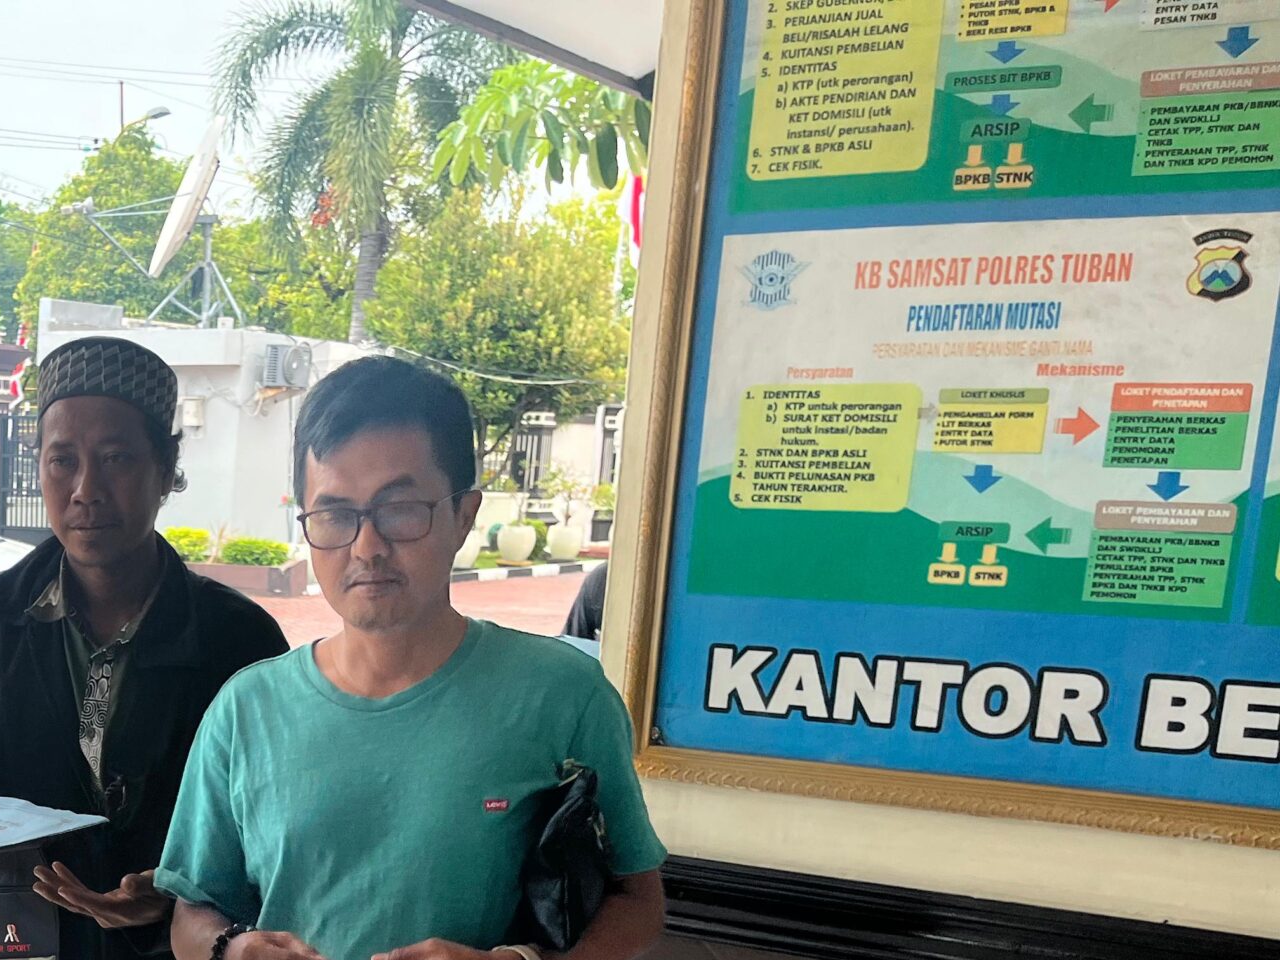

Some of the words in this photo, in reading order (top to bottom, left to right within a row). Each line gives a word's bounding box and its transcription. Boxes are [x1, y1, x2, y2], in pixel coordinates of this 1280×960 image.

[768, 4, 777, 13] 2.
[1156, 4, 1188, 14] ENTRY
[1192, 2, 1218, 10] DATA
[766, 20, 776, 29] 3.
[784, 12, 852, 27] PERJANJIAN
[855, 9, 883, 20] JUAL
[1154, 16, 1186, 25] PESAN
[1191, 13, 1217, 21] TNKB
[783, 27, 859, 43] BELI/RISALAH
[864, 23, 909, 35] LELANG
[763, 52, 772, 61] 4.
[781, 46, 832, 60] KUITANSI
[836, 40, 904, 54] PEMBELIAN
[761, 68, 770, 77] 5.
[779, 61, 837, 76] IDENTITAS
[1151, 71, 1181, 81] LOKET
[1185, 66, 1259, 79] PEMBAYARAN
[777, 82, 788, 93] a)
[792, 79, 813, 91] KTP
[817, 77, 839, 90] (utk
[842, 71, 913, 88] perorangan)
[954, 75, 996, 86] PROSES
[1000, 73, 1018, 82] BIT
[1021, 71, 1051, 81] BPKB
[1180, 79, 1252, 91] PENYERAHAN
[776, 98, 786, 110] b)
[790, 96, 818, 107] AKTE
[822, 91, 886, 104] PENDIRIAN
[890, 88, 916, 99] DAN
[789, 113, 809, 124] KET
[812, 109, 864, 121] DOMISILI
[869, 106, 891, 119] (utk
[1151, 104, 1220, 115] PEMBAYARAN
[1149, 118, 1170, 126] DAN
[787, 125, 835, 139] instansi/
[838, 121, 914, 138] perusahaan).
[971, 122, 1020, 137] ARSIP
[1148, 128, 1179, 136] CETAK
[1207, 125, 1234, 133] STNK
[1238, 123, 1259, 131] DAN
[1147, 139, 1172, 147] TNKB
[753, 149, 762, 158] 6.
[770, 145, 799, 157] STNK
[802, 144, 811, 154] &
[815, 142, 844, 153] BPKB
[848, 140, 872, 150] ASLI
[1145, 147, 1212, 157] PENYERAHAN
[1241, 144, 1269, 152] STNK
[752, 164, 760, 174] 7.
[768, 162, 789, 172] CEK
[792, 159, 822, 170] FISIK.
[1168, 159, 1194, 167] TNKB
[1198, 158, 1218, 166] KPD
[1222, 155, 1274, 164] PEMOHON
[955, 174, 990, 185] BPKB
[996, 172, 1033, 183] STNK
[854, 260, 882, 289] KB
[887, 257, 971, 288] SAMSAT
[976, 254, 1054, 285] POLRES
[1061, 253, 1133, 283] TUBAN
[907, 303, 1004, 332] PENDAFTARAN
[1006, 301, 1062, 330] MUTASI
[787, 367, 854, 379] Persyaratan
[1037, 363, 1125, 377] Mekanisme
[746, 391, 755, 399] 1.
[763, 390, 820, 399] IDENTITAS
[767, 403, 777, 412] a)
[785, 402, 805, 410] KTP
[808, 402, 837, 410] untuk
[841, 403, 902, 413] perorangan
[766, 414, 776, 424] b)
[784, 414, 818, 422] SURAT
[821, 414, 841, 422] KET
[844, 414, 898, 422] DOMISILI
[1117, 416, 1183, 424] PENYERAHAN
[783, 426, 811, 434] untuk
[1115, 426, 1174, 434] PENELITIAN
[1178, 427, 1217, 435] BERKAS
[781, 437, 818, 445] hukum.
[756, 449, 784, 457] STNK
[755, 461, 806, 469] KUITANSI
[808, 461, 871, 469] PEMBELIAN
[1111, 456, 1168, 464] PENETAPAN
[788, 472, 851, 481] PELUNASAN
[854, 473, 875, 481] PKB
[752, 483, 788, 491] TAHUN
[791, 484, 847, 493] TERAKHIR.
[1131, 517, 1198, 525] PENYERAHAN
[955, 526, 993, 537] ARSIP
[1177, 557, 1197, 565] DAN
[933, 570, 960, 578] BPKB
[975, 572, 1003, 580] STNK
[705, 644, 1106, 745] KANTOR
[7, 944, 31, 952] SPORT
